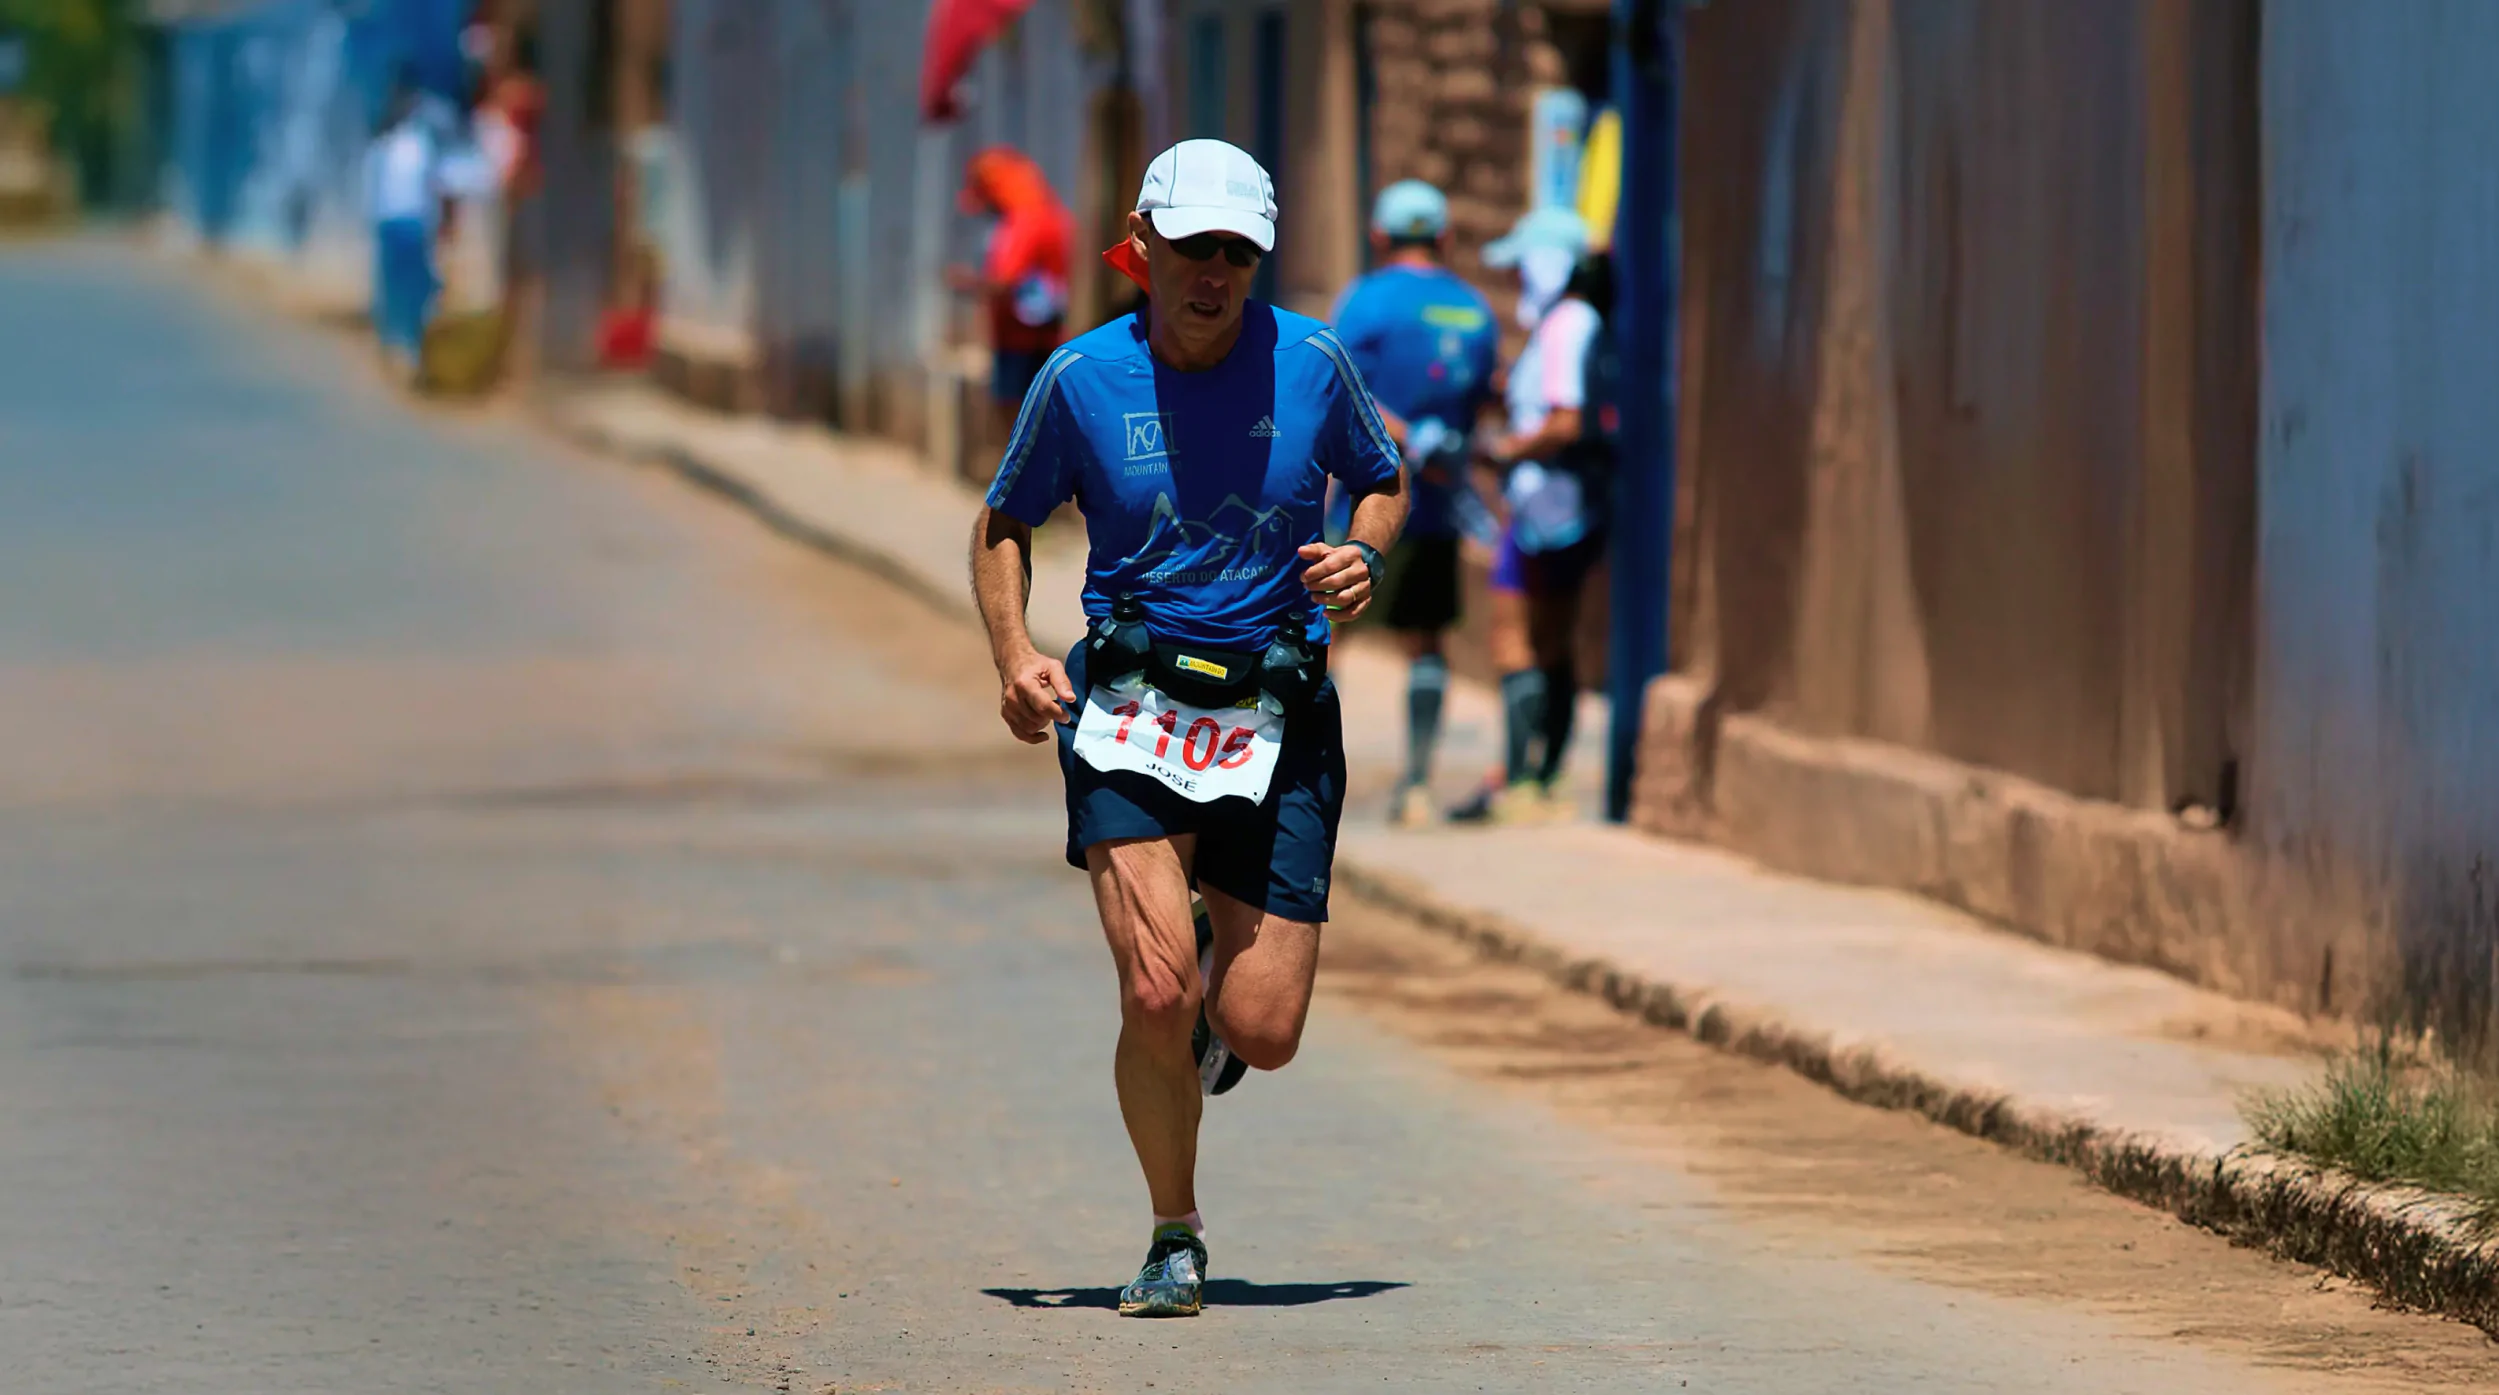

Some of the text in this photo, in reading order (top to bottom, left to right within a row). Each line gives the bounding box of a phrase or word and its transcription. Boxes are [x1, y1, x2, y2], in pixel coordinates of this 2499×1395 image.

[1249, 429, 1281, 438] adidas
[1124, 462, 1168, 477] MOUNTAIN
[1141, 570, 1196, 585] DESERTO
[1200, 570, 1217, 584] DO
[1113, 700, 1257, 772] 1105
[1147, 763, 1198, 793] JOSÉ
